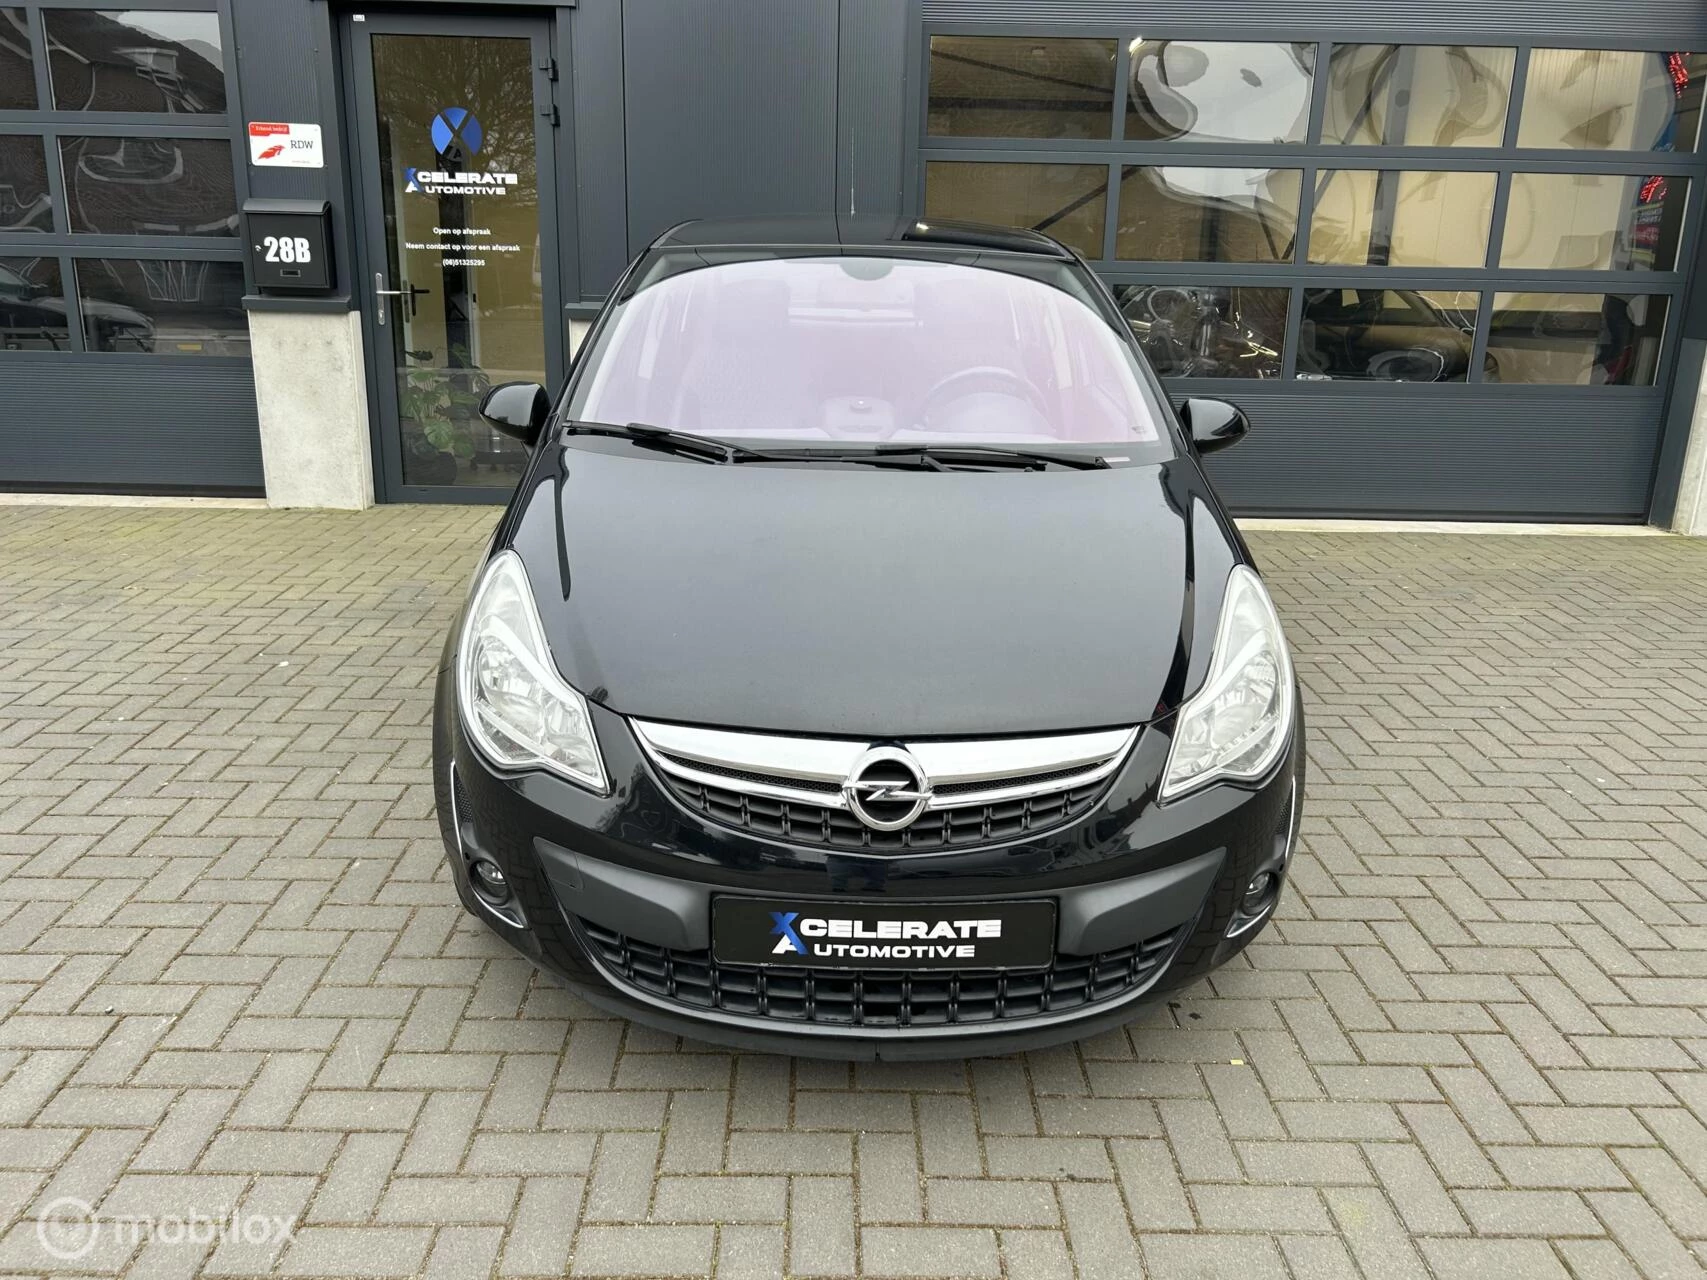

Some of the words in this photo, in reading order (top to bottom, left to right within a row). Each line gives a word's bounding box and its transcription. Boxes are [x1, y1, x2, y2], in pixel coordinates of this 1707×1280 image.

[290, 140, 313, 149] RDW
[433, 227, 451, 235] Open
[462, 228, 491, 236] afspraak
[263, 236, 311, 263] 28B
[405, 242, 425, 250] Neem
[491, 244, 520, 252] afspraak
[772, 935, 975, 958] AUTOMOTIVE
